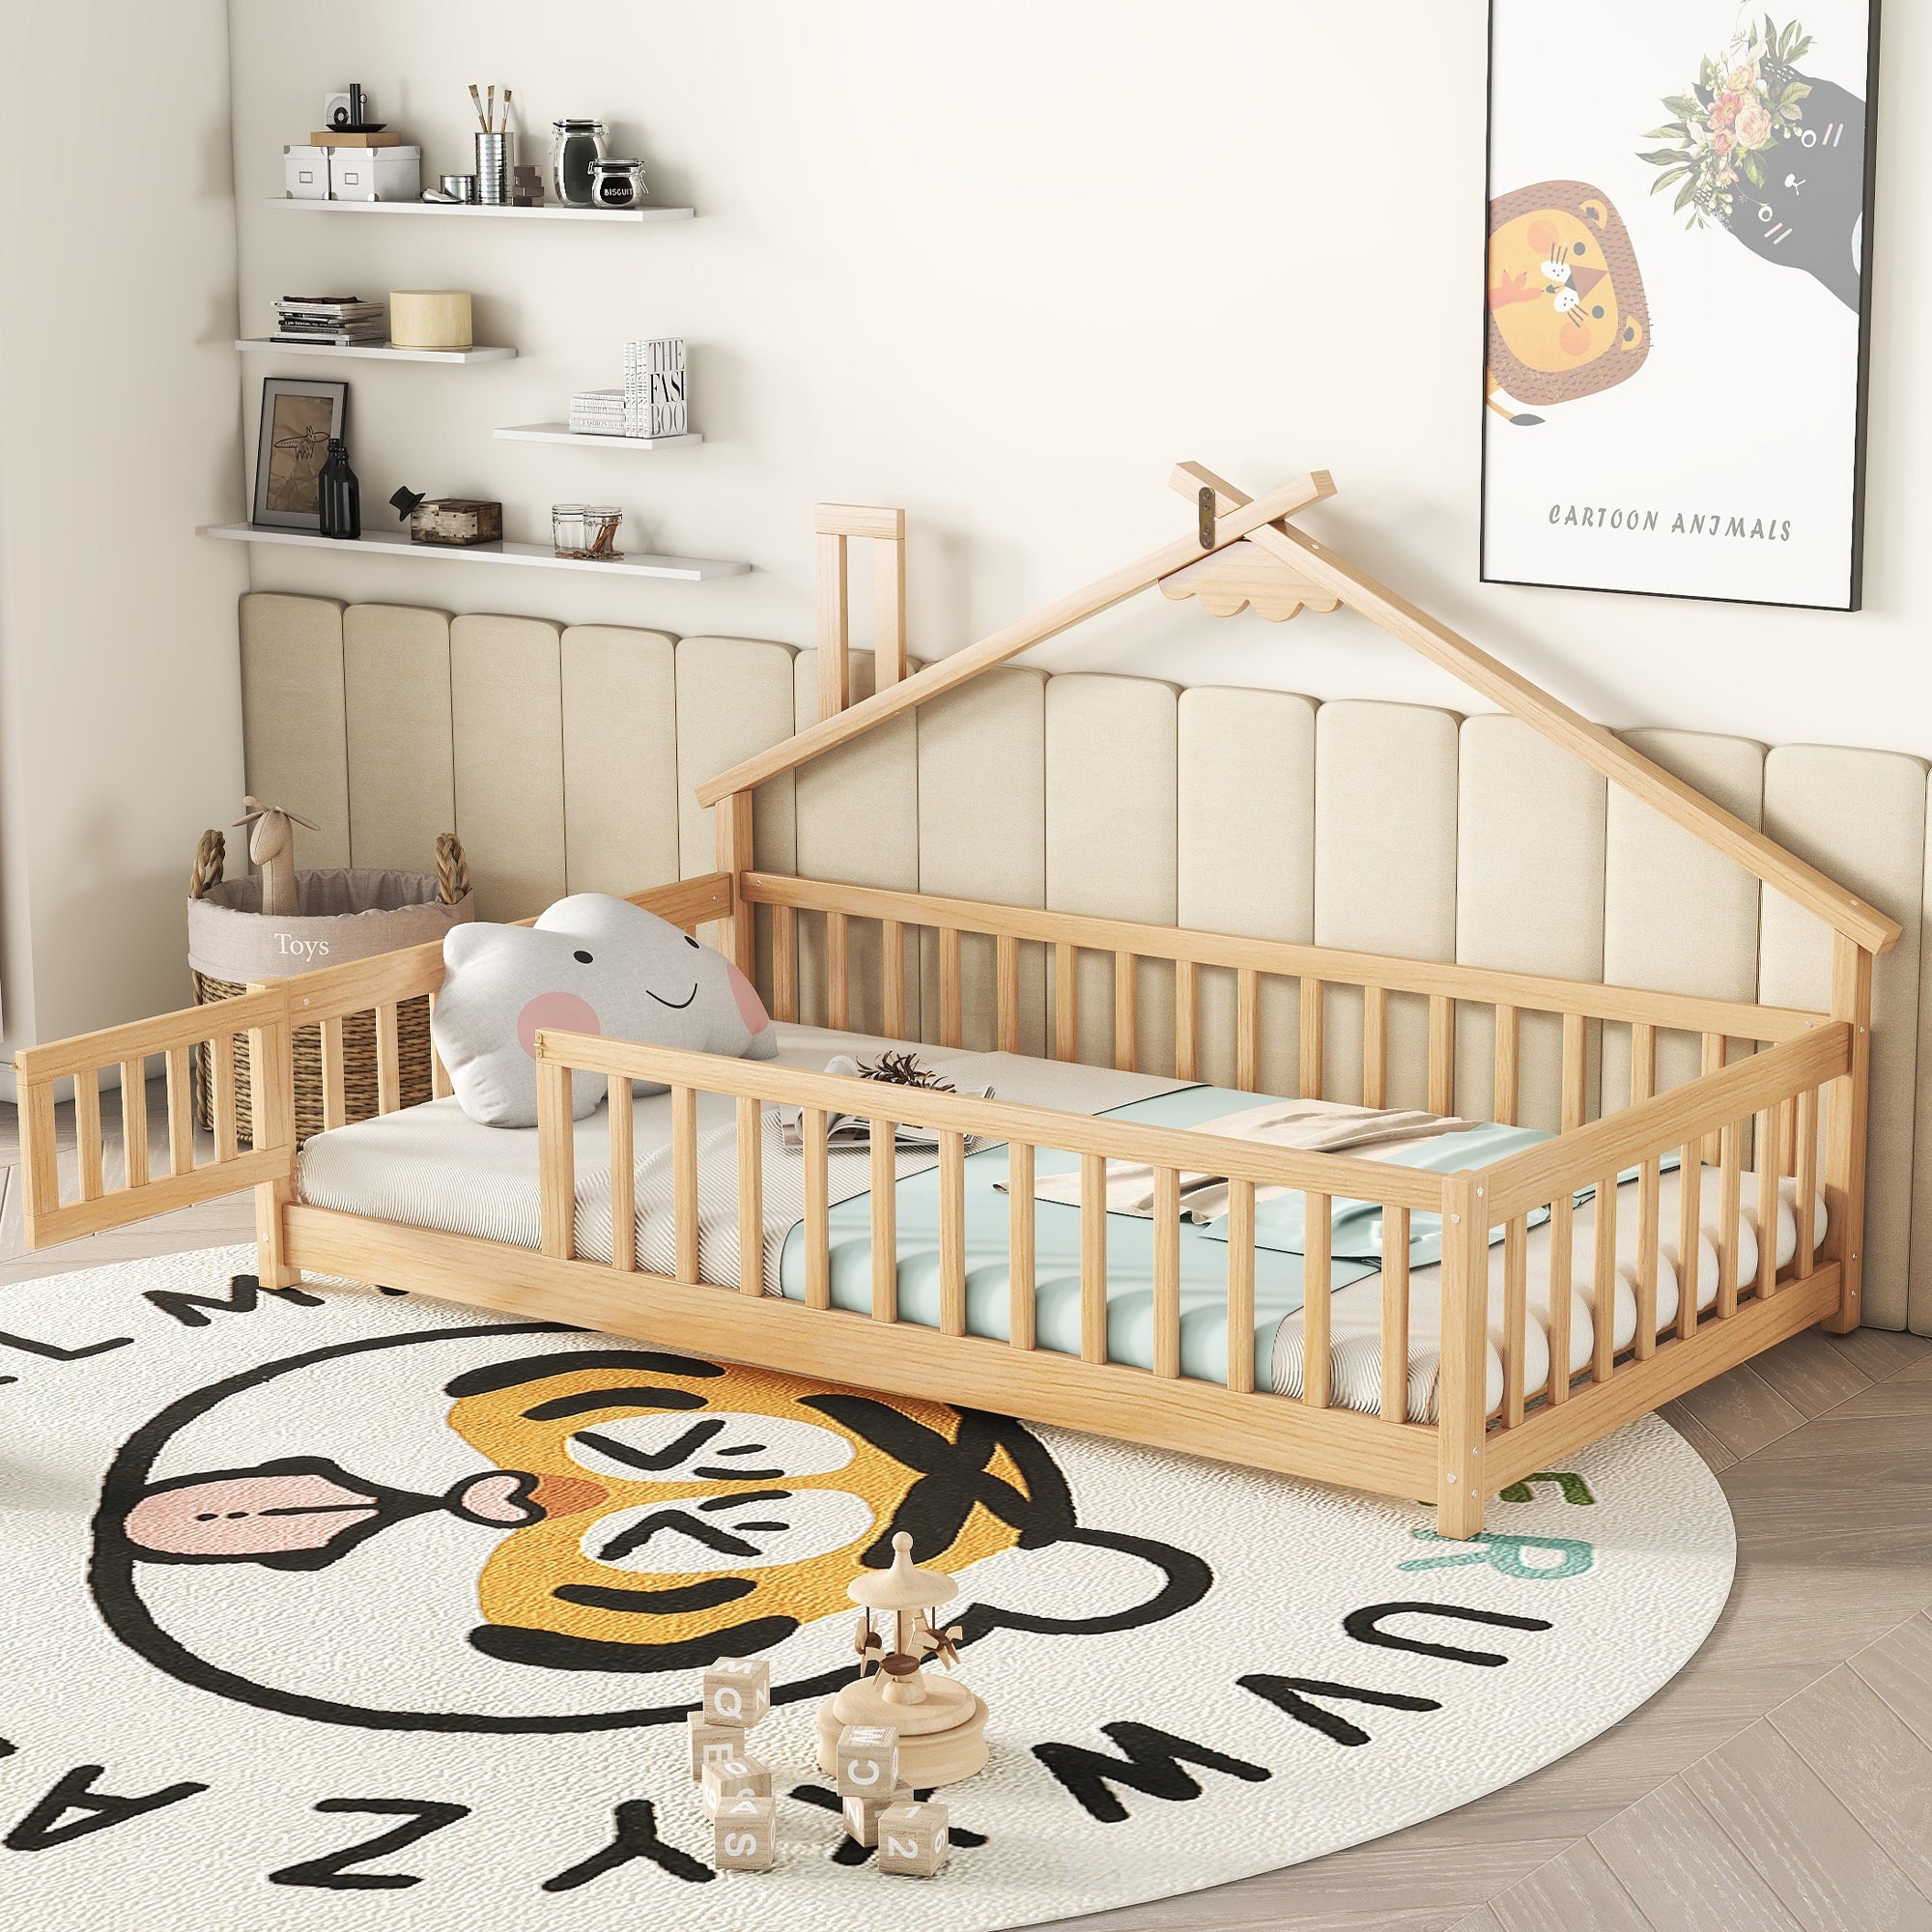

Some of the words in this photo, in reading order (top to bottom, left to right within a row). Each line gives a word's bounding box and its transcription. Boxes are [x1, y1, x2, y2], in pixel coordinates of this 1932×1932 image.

[649, 340, 685, 372] THE
[650, 403, 685, 436] BOO
[1548, 504, 1659, 531] CARTOON
[1671, 513, 1791, 541] ANIMALS
[273, 933, 329, 962] Toys
[1398, 1520, 1594, 1580] R
[714, 1688, 743, 1720] Q
[847, 1759, 880, 1786] C
[2, 1764, 210, 1851] A
[728, 1800, 758, 1814] A
[542, 1800, 716, 1891] Y
[724, 1832, 757, 1857] S
[888, 1836, 918, 1860] 2
